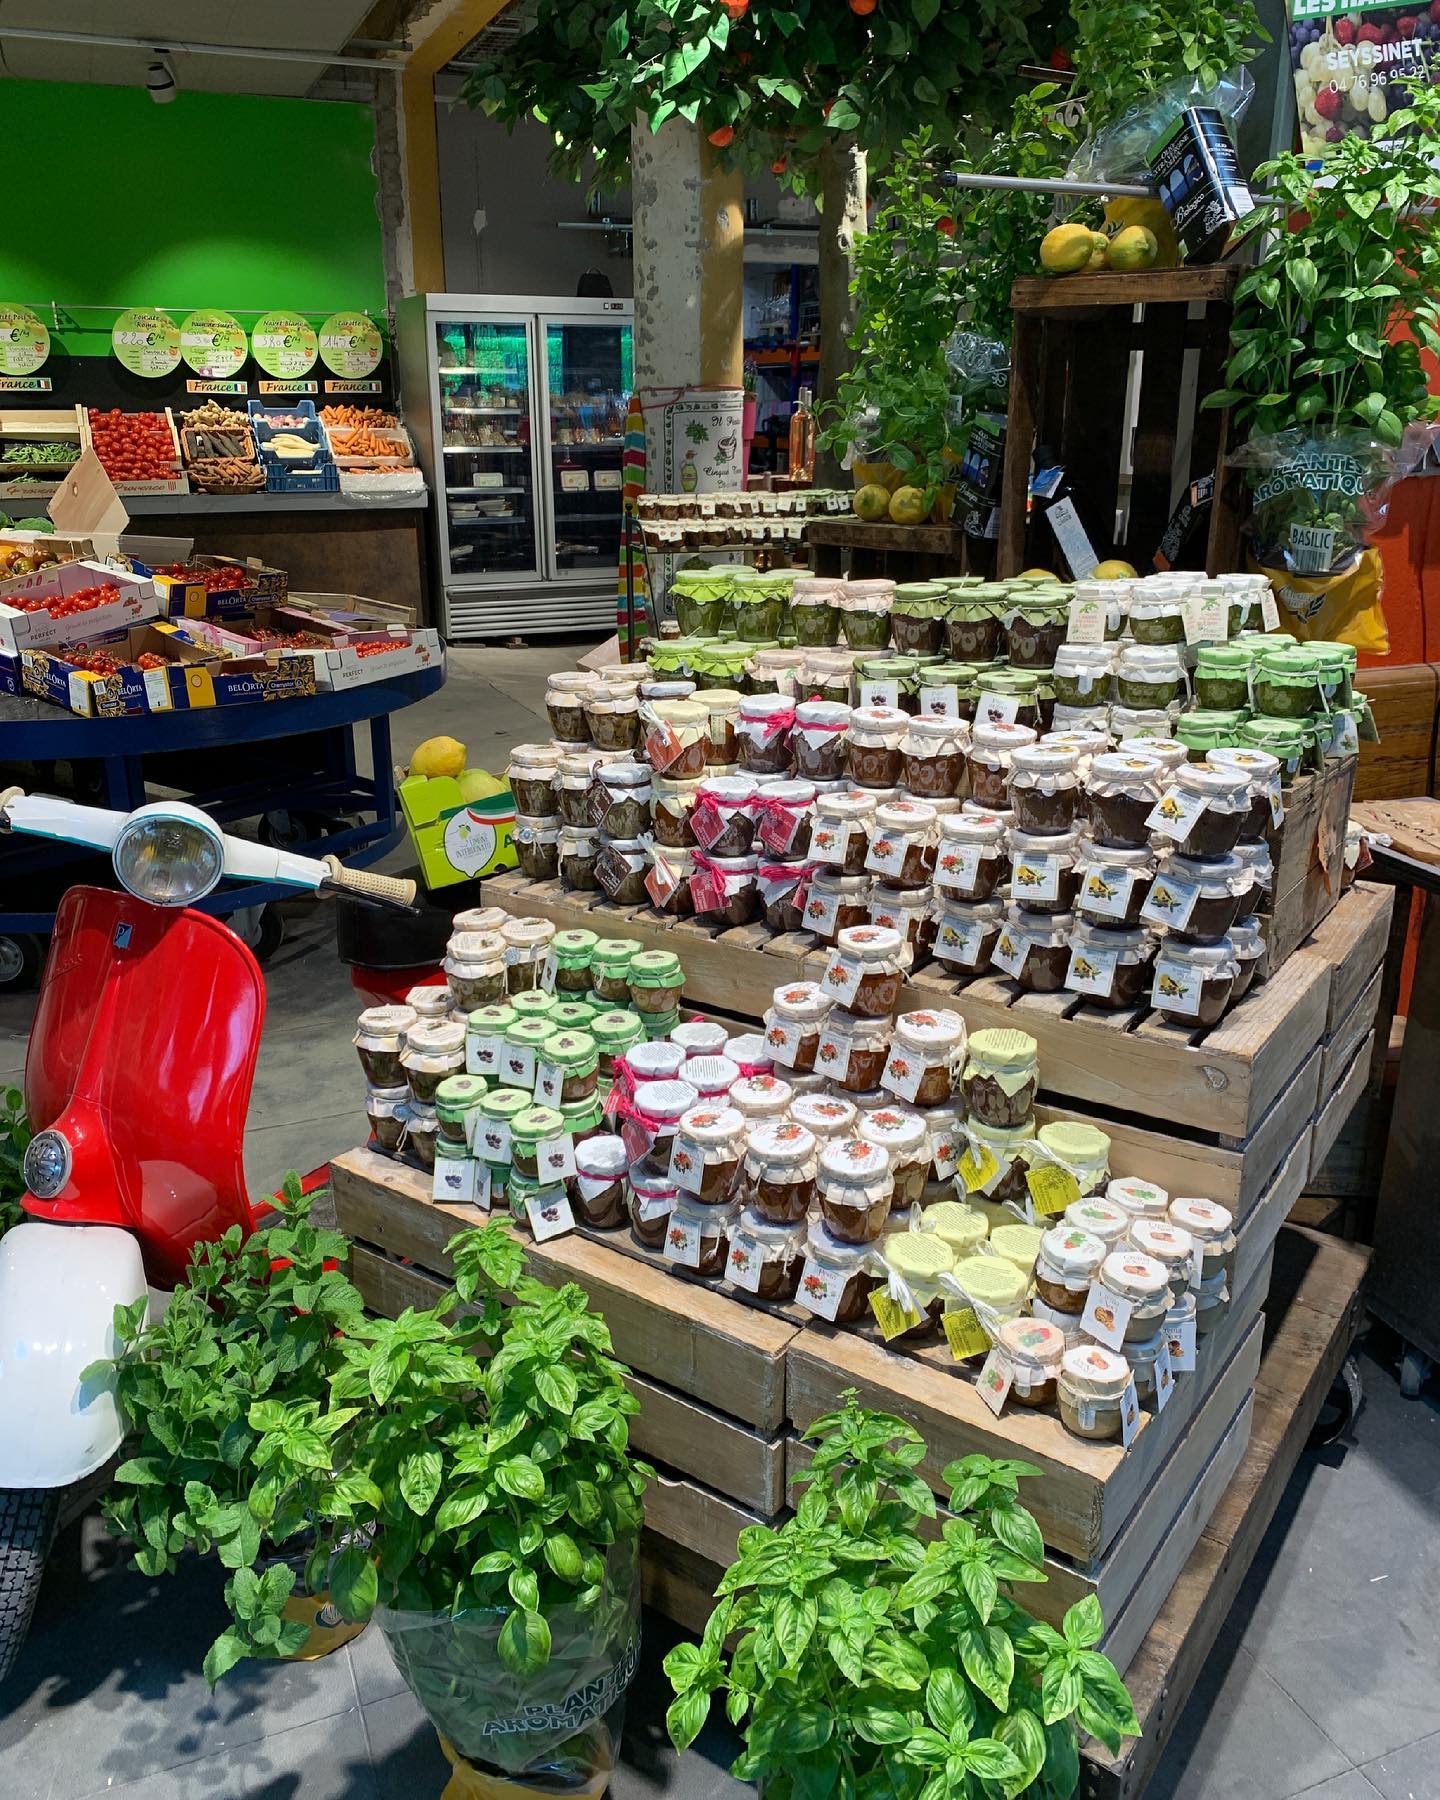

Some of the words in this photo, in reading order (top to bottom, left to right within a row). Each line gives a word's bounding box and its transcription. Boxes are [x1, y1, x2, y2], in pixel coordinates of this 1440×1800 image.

[1327, 38, 1423, 70] SEYSSINET
[1329, 79, 1348, 93] 04
[1352, 75, 1367, 89] 76
[1370, 72, 1387, 87] 96
[1411, 65, 1426, 79] 22
[194, 381, 233, 391] France
[266, 381, 304, 392] France
[331, 381, 368, 391] France
[1292, 528, 1331, 549] BASILIC
[30, 630, 56, 640] PERFECT
[342, 669, 363, 678] PERFECT
